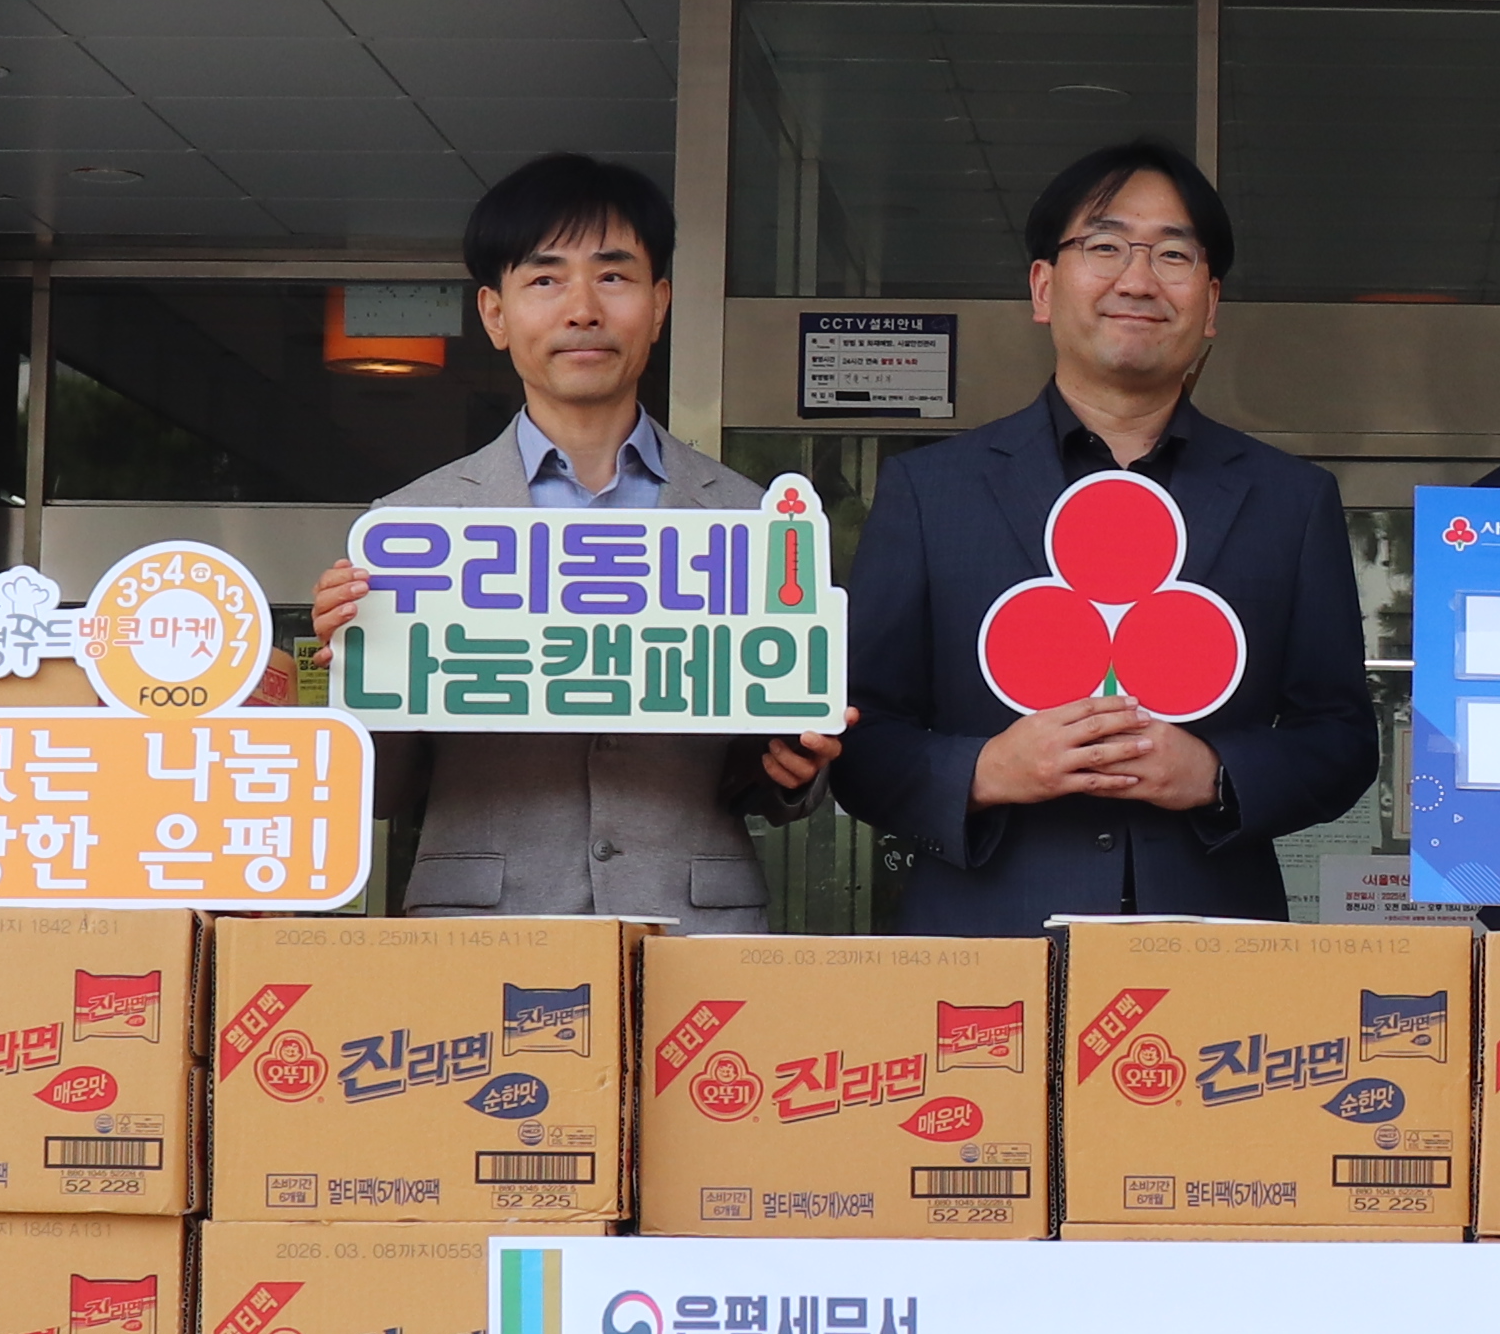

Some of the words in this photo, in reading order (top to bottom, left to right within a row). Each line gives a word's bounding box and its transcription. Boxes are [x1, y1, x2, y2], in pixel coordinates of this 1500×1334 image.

[360, 520, 750, 616] 우리동네
[139, 686, 208, 707] FOOD
[343, 620, 830, 719] 나눔캠페인
[143, 727, 332, 804] 나눔!
[138, 814, 328, 894] 은평!
[336, 1028, 494, 1104] 진라면
[658, 1009, 719, 1071] 멀티팩
[1194, 1032, 1351, 1108] 진라면
[702, 1086, 750, 1103] 오뚜기
[771, 1047, 928, 1122] 진라면
[916, 1098, 976, 1131] 매운맛
[967, 1210, 1006, 1224] 228
